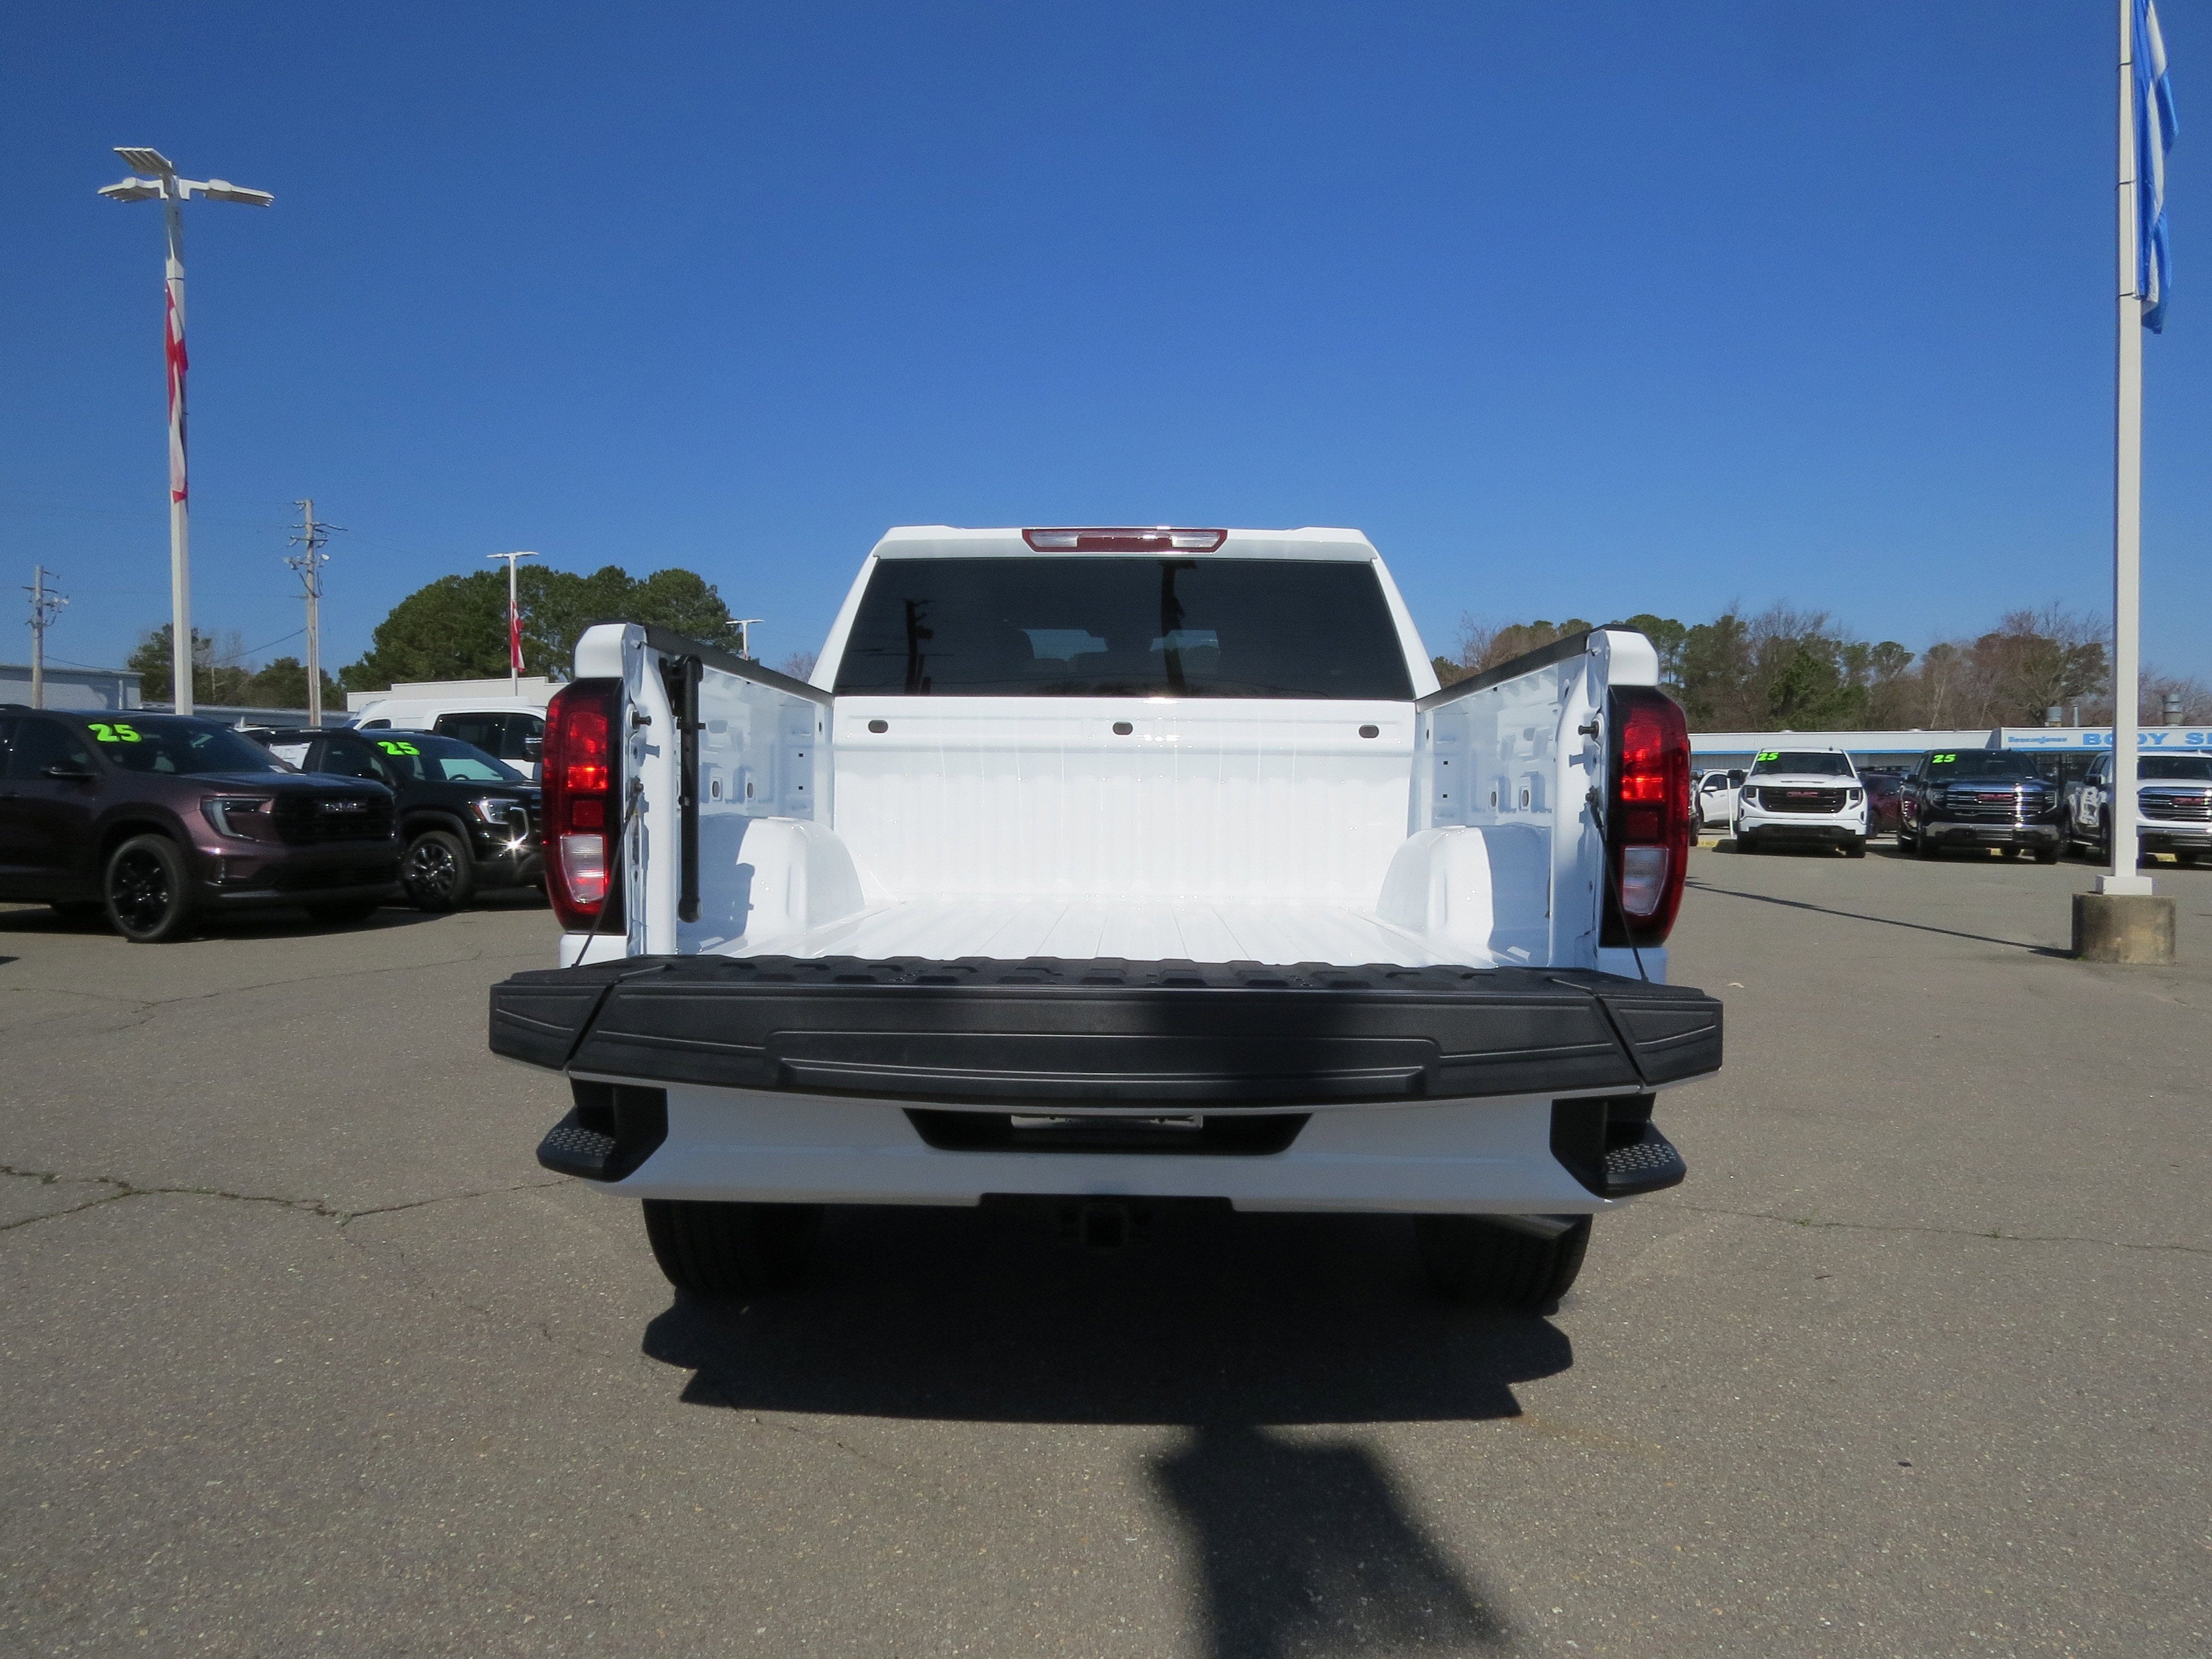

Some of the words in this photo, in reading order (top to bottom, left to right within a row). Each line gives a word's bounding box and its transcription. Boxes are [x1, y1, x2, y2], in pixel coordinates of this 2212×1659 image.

[87, 723, 142, 743] 25
[2185, 733, 2212, 745] S
[377, 741, 420, 756] 25
[1757, 752, 1779, 761] 25
[1932, 754, 1957, 763] 25
